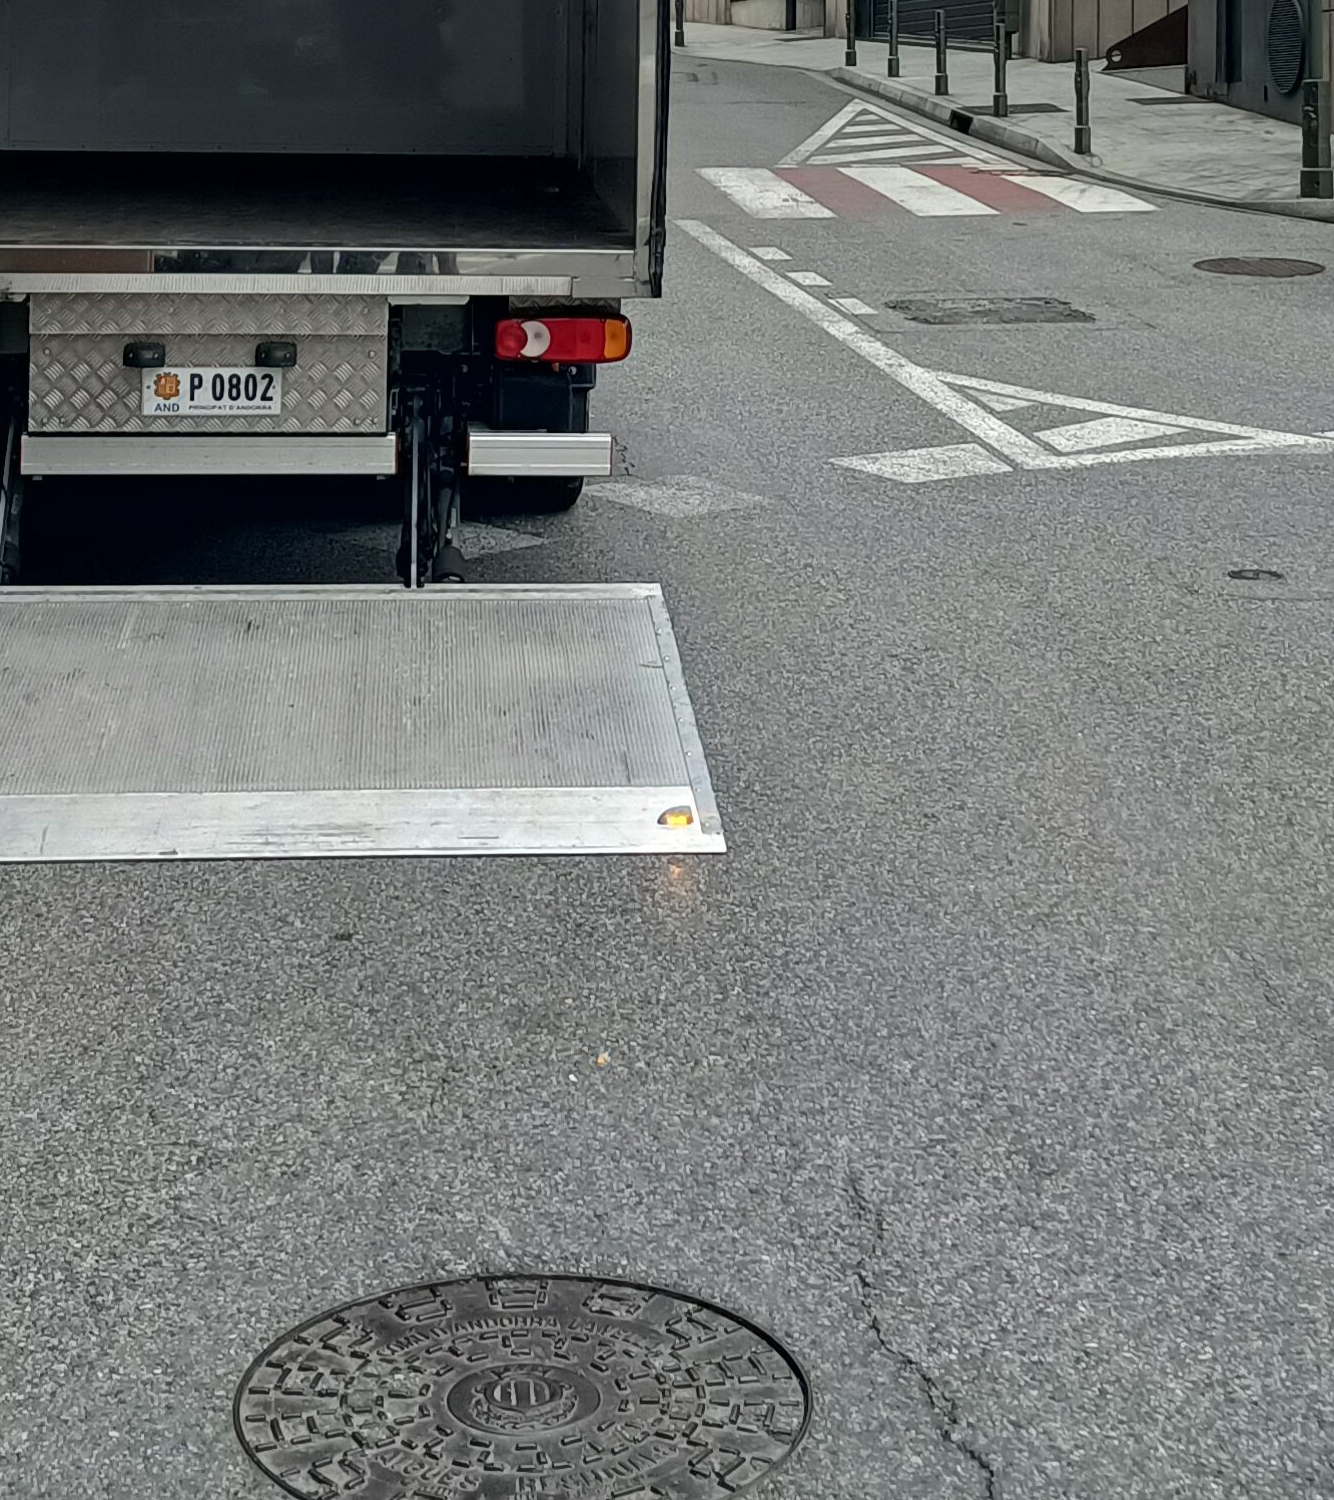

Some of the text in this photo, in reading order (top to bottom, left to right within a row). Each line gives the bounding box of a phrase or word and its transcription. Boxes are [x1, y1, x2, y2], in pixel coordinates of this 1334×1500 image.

[189, 373, 274, 402] P 0802
[154, 403, 180, 413] AND
